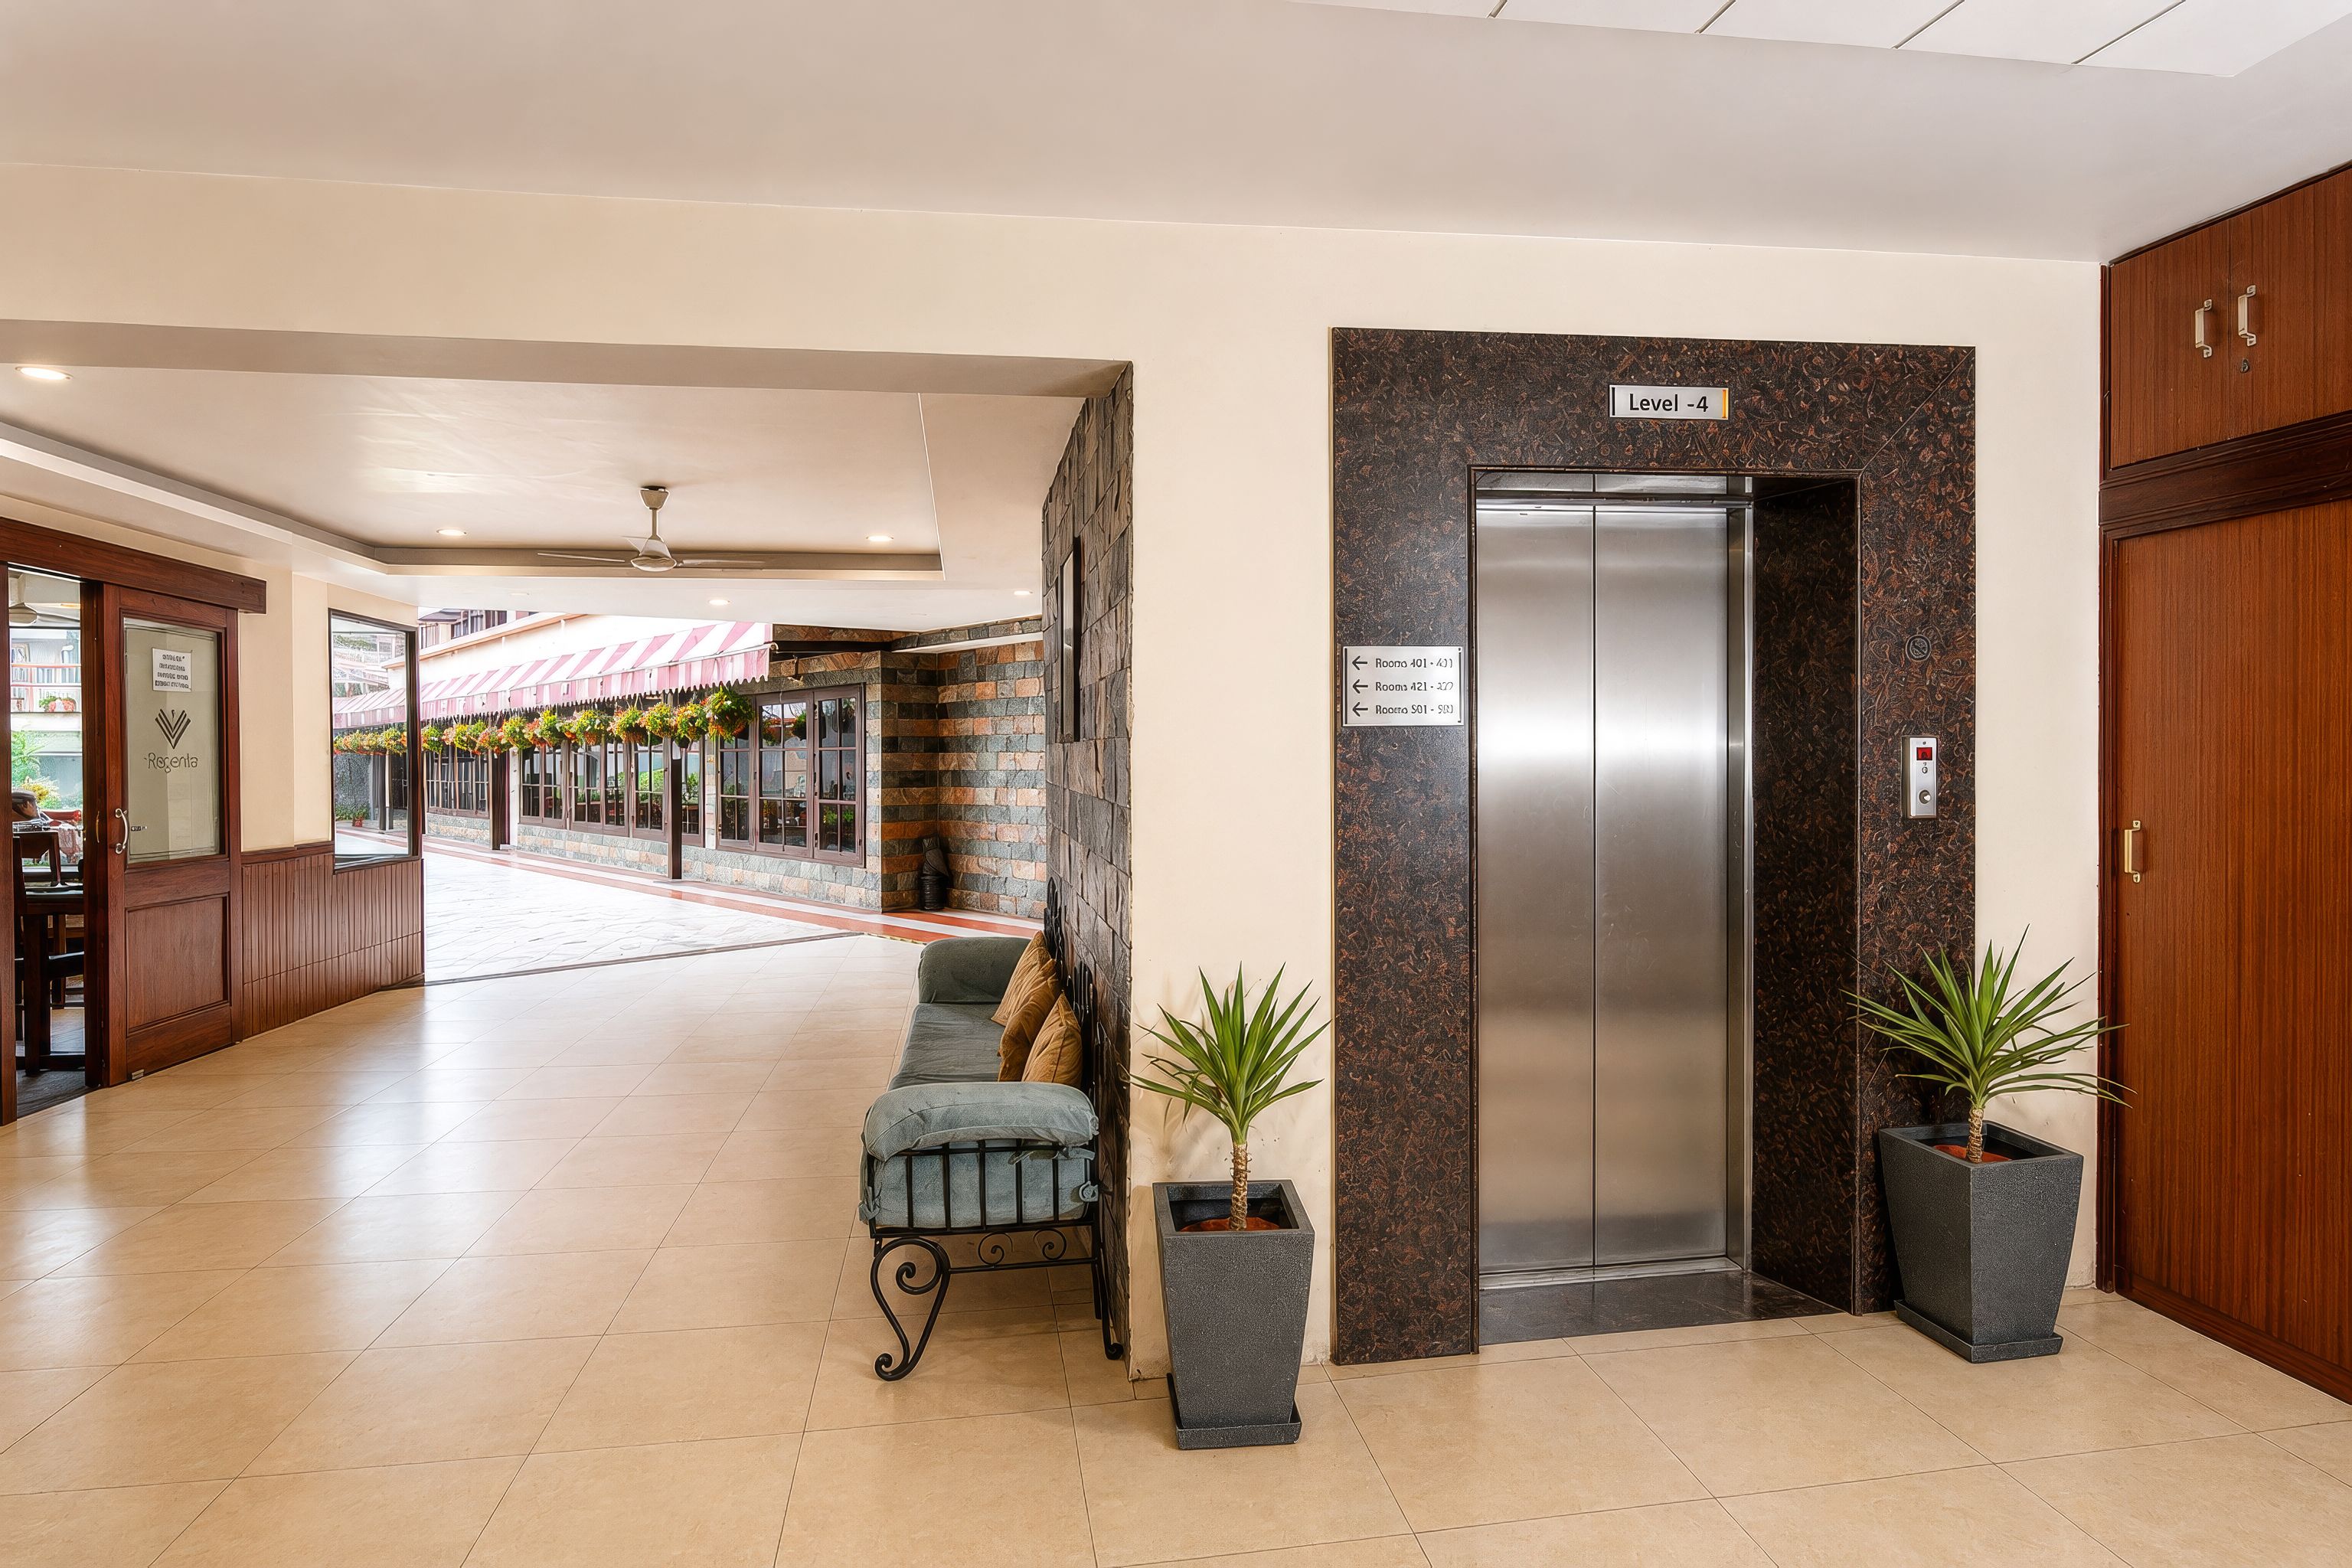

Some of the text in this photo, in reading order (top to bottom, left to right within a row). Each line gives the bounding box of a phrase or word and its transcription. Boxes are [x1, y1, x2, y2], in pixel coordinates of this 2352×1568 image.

[1629, 393, 1709, 413] Level -4
[1375, 658, 1408, 668] Rooms
[1410, 658, 1427, 668] 401
[1375, 681, 1408, 691] Rooms
[1410, 681, 1428, 691] 421
[1375, 704, 1408, 714] Rooms
[1411, 704, 1428, 714] 501
